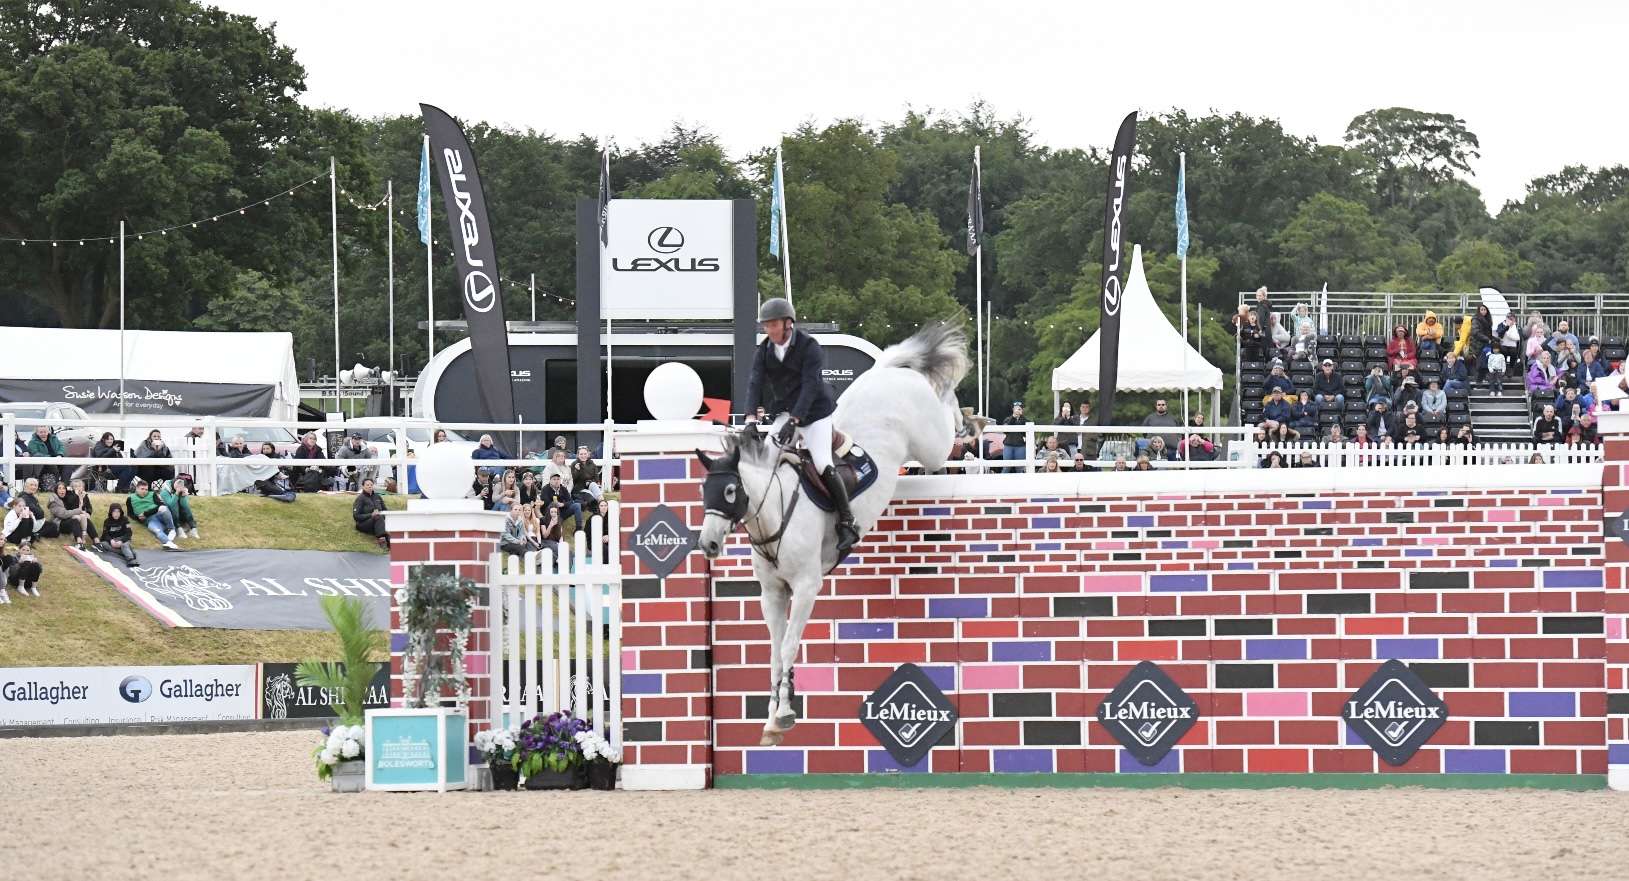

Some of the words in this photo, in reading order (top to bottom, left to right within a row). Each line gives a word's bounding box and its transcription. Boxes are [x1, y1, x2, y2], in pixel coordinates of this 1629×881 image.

[1109, 155, 1127, 271] LEXUS
[612, 257, 720, 272] LEXUS
[62, 385, 96, 399] Susie
[144, 386, 183, 407] Designs
[635, 533, 689, 546] LeMieux
[239, 577, 308, 597] AL
[303, 577, 391, 597] SHI
[2, 680, 89, 705] Gallagher
[159, 678, 242, 702] Gallagher
[295, 686, 318, 706] AL
[864, 701, 951, 722] LeMieux
[1103, 701, 1192, 720] LeMieux
[1348, 700, 1440, 719] LeMieux
